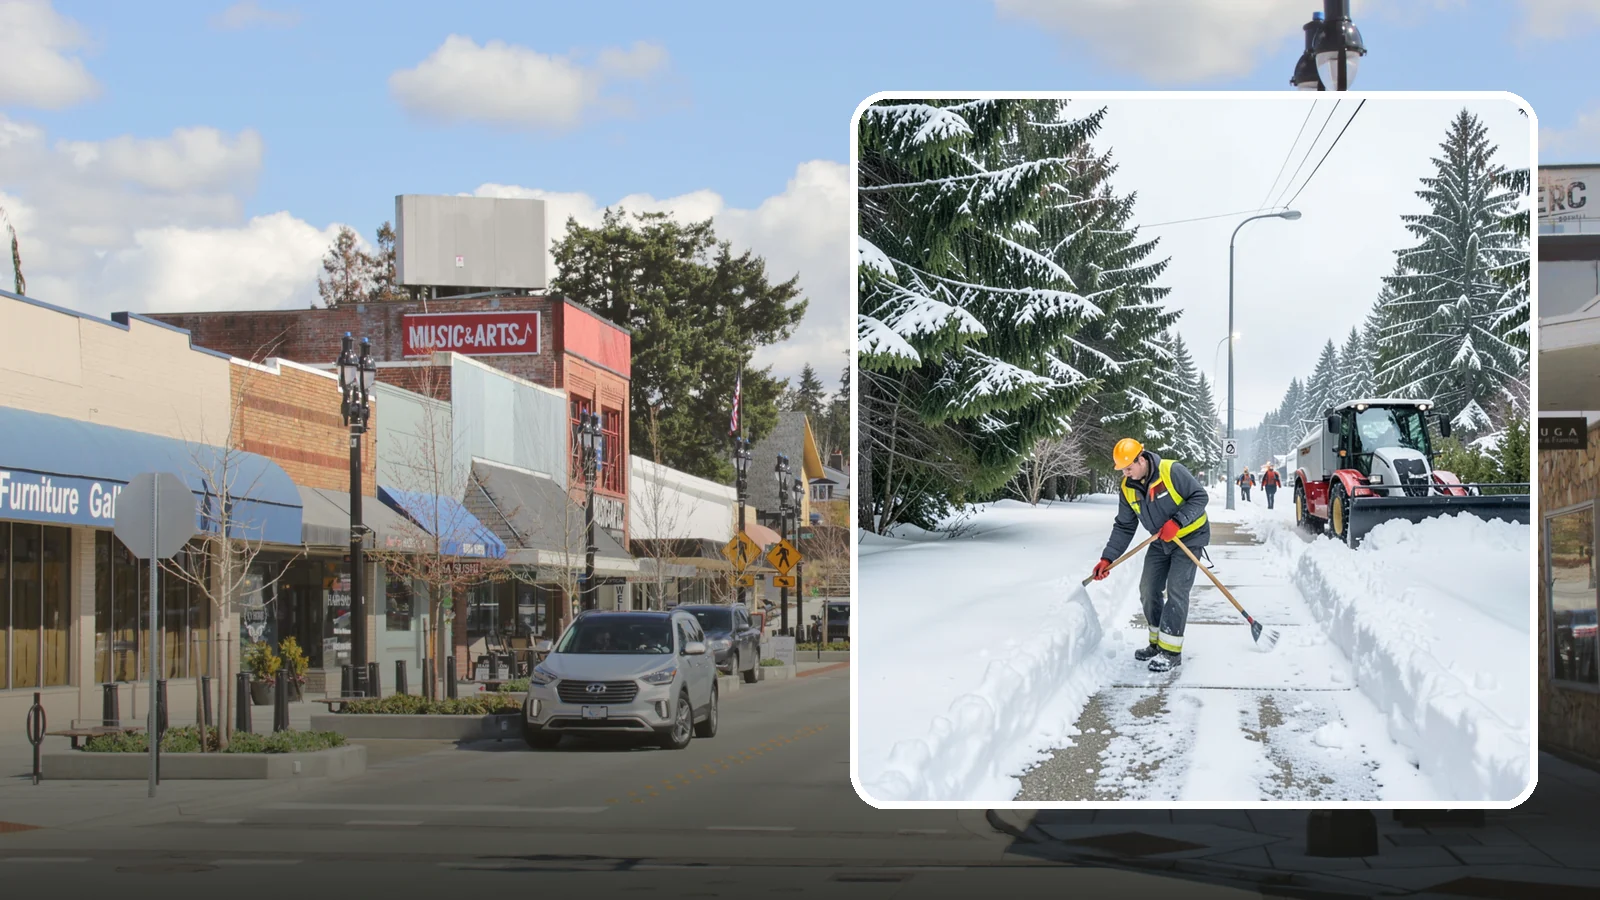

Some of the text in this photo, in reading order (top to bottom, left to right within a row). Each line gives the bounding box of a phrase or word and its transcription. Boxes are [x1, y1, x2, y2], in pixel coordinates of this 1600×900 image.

[1540, 427, 1577, 437] UGA
[0, 471, 121, 519] Furniture Gal
[453, 563, 479, 574] SUSHI
